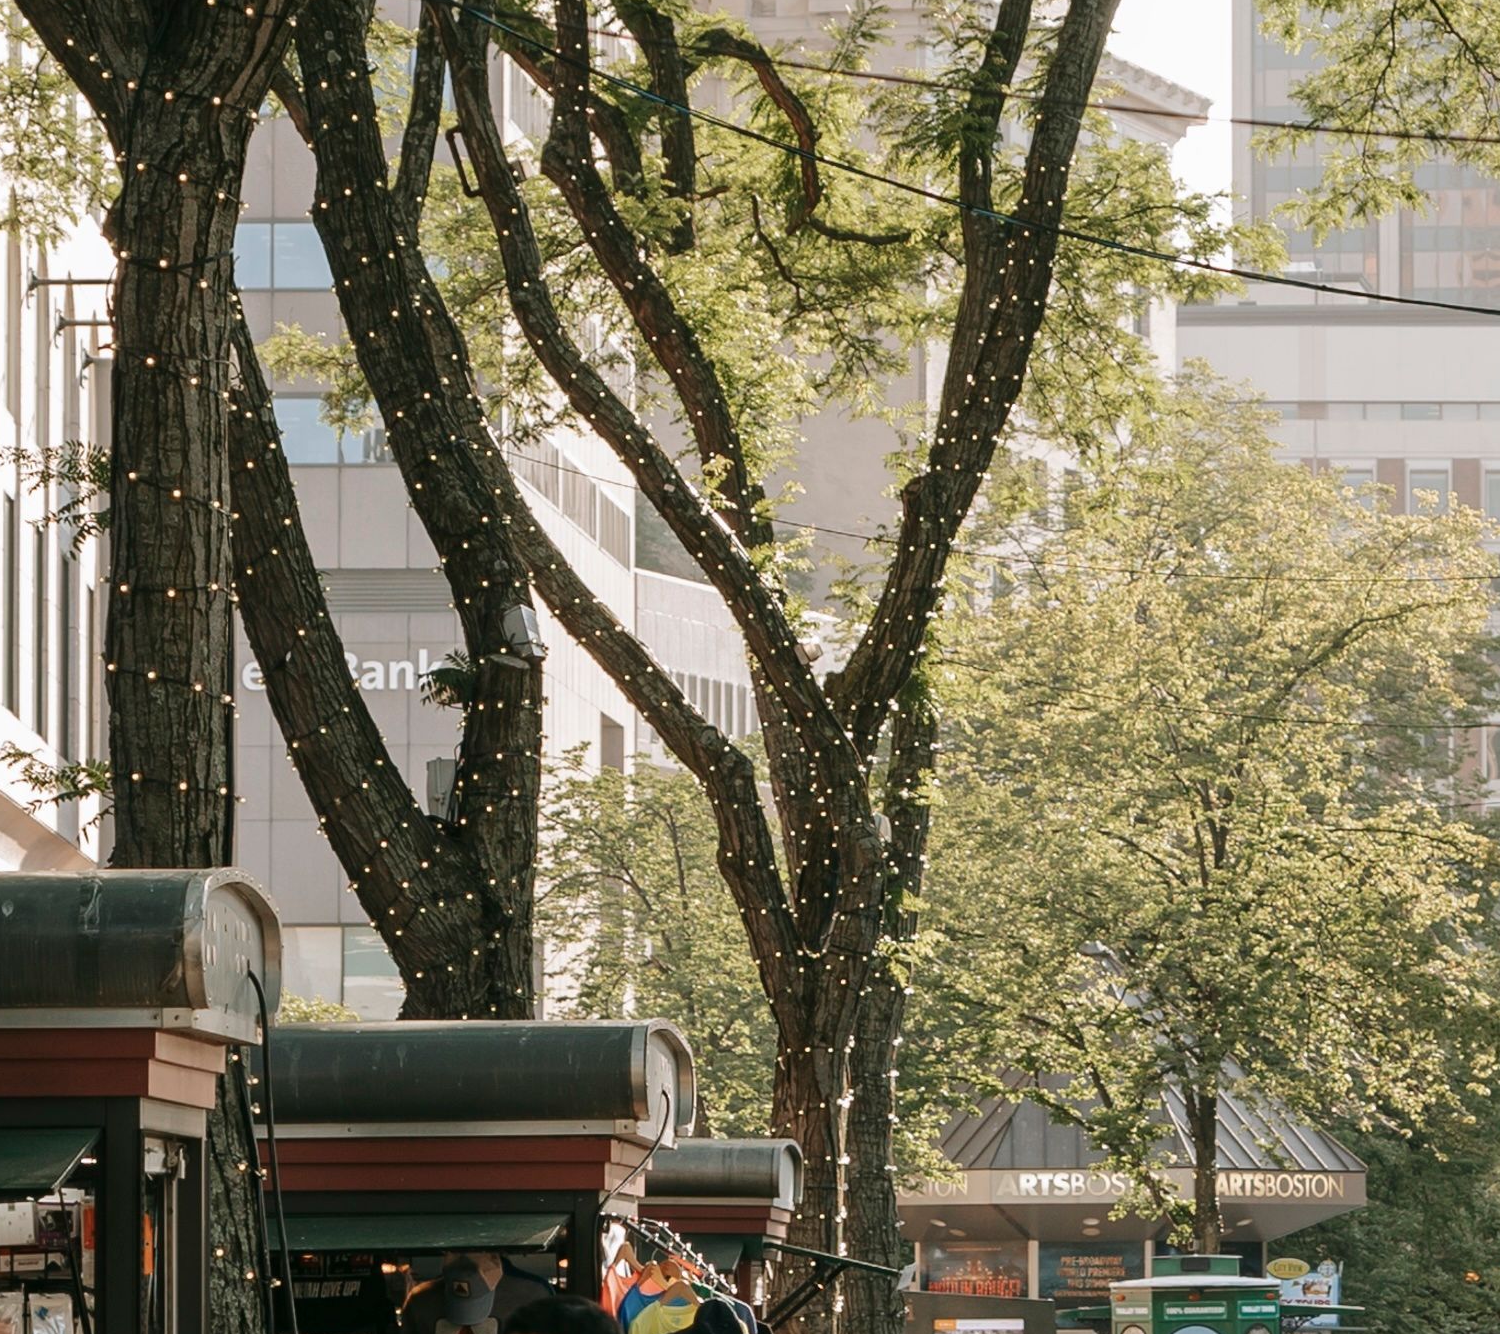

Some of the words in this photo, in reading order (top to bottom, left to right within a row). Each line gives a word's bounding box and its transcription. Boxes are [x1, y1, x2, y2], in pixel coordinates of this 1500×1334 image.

[1215, 1174, 1344, 1197] ARTSBOSTON
[321, 1281, 343, 1298] GIVE
[343, 1280, 361, 1297] UP!
